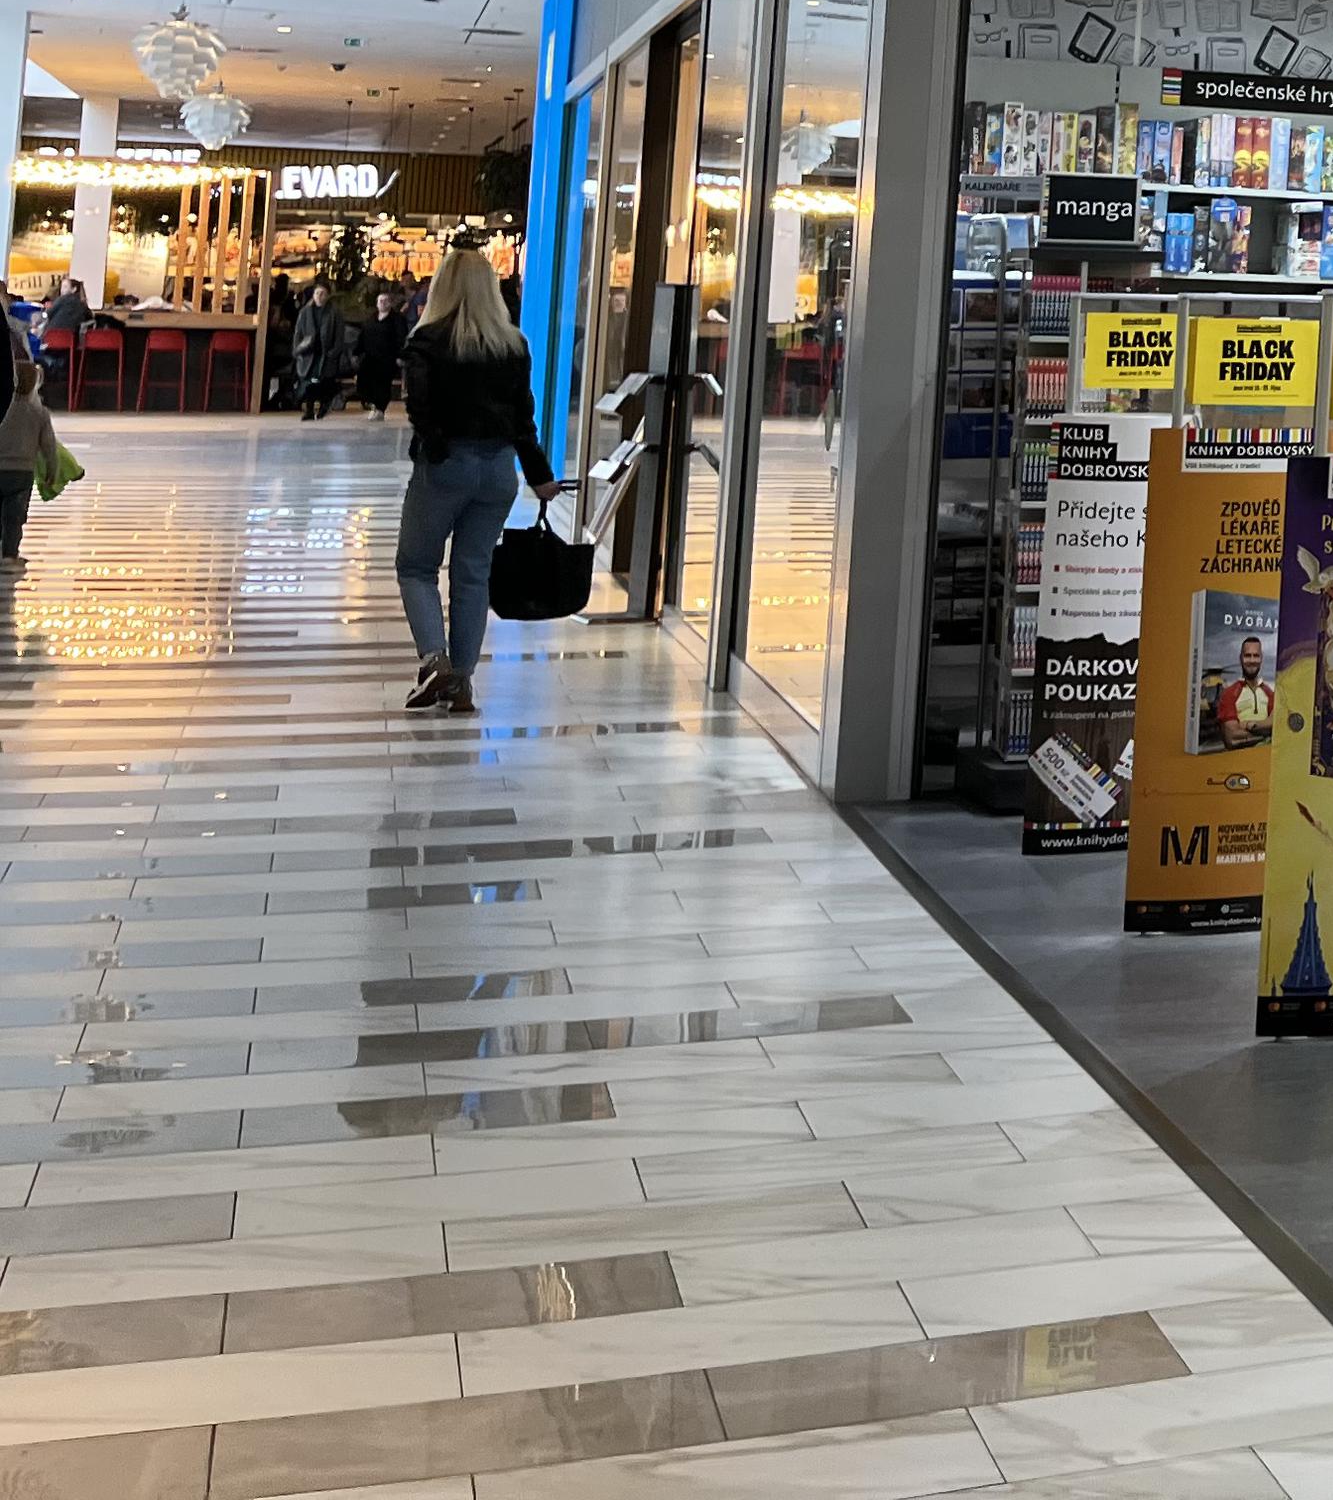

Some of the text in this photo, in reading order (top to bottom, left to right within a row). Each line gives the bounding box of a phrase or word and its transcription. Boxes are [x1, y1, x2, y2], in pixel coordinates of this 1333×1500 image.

[1196, 80, 1306, 102] společenské
[276, 164, 379, 199] EVARD
[1056, 199, 1133, 222] manga
[1108, 331, 1173, 348] BLACK
[1106, 350, 1175, 368] FRIDAY
[1221, 339, 1294, 360] BLACK
[1218, 361, 1296, 382] FRIDAY
[1063, 426, 1104, 441] KLUB
[1061, 445, 1113, 460] KNIHY
[1189, 442, 1314, 457] KNIHY DOBROVSKÝ
[1057, 500, 1136, 525] Přidejte
[1220, 518, 1280, 536] LÉKAŘE
[1055, 529, 1129, 548] našeho
[1215, 536, 1282, 555] LETECKÉ
[1045, 655, 1139, 677] DÁRKOV
[1044, 683, 1137, 701] POUKAZ
